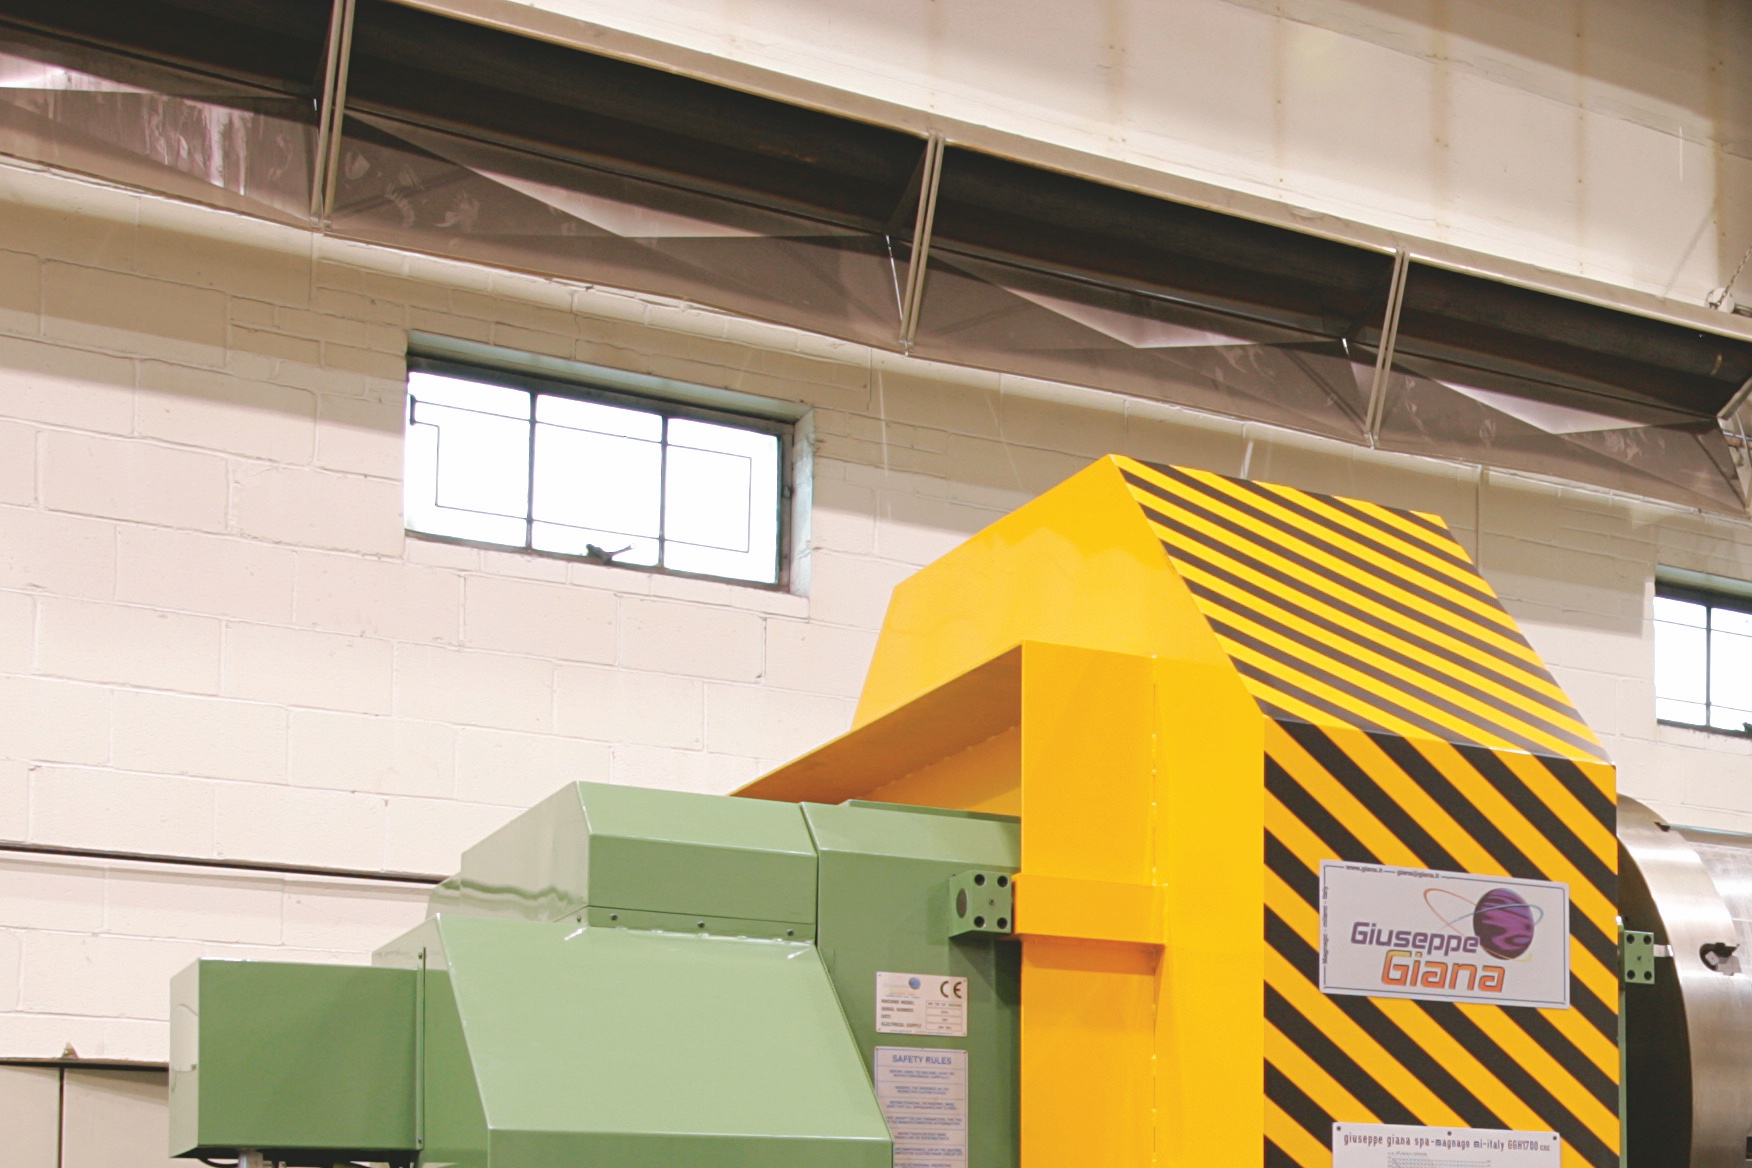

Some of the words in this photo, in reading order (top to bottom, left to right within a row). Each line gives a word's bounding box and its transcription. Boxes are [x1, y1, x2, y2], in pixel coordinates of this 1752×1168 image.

[1350, 922, 1480, 957] Giuseppe
[1381, 949, 1506, 993] Giana
[892, 1055, 923, 1064] SAFETY
[925, 1056, 952, 1065] RULES
[1344, 1132, 1383, 1147] giuseppe
[1387, 1134, 1411, 1147] giana
